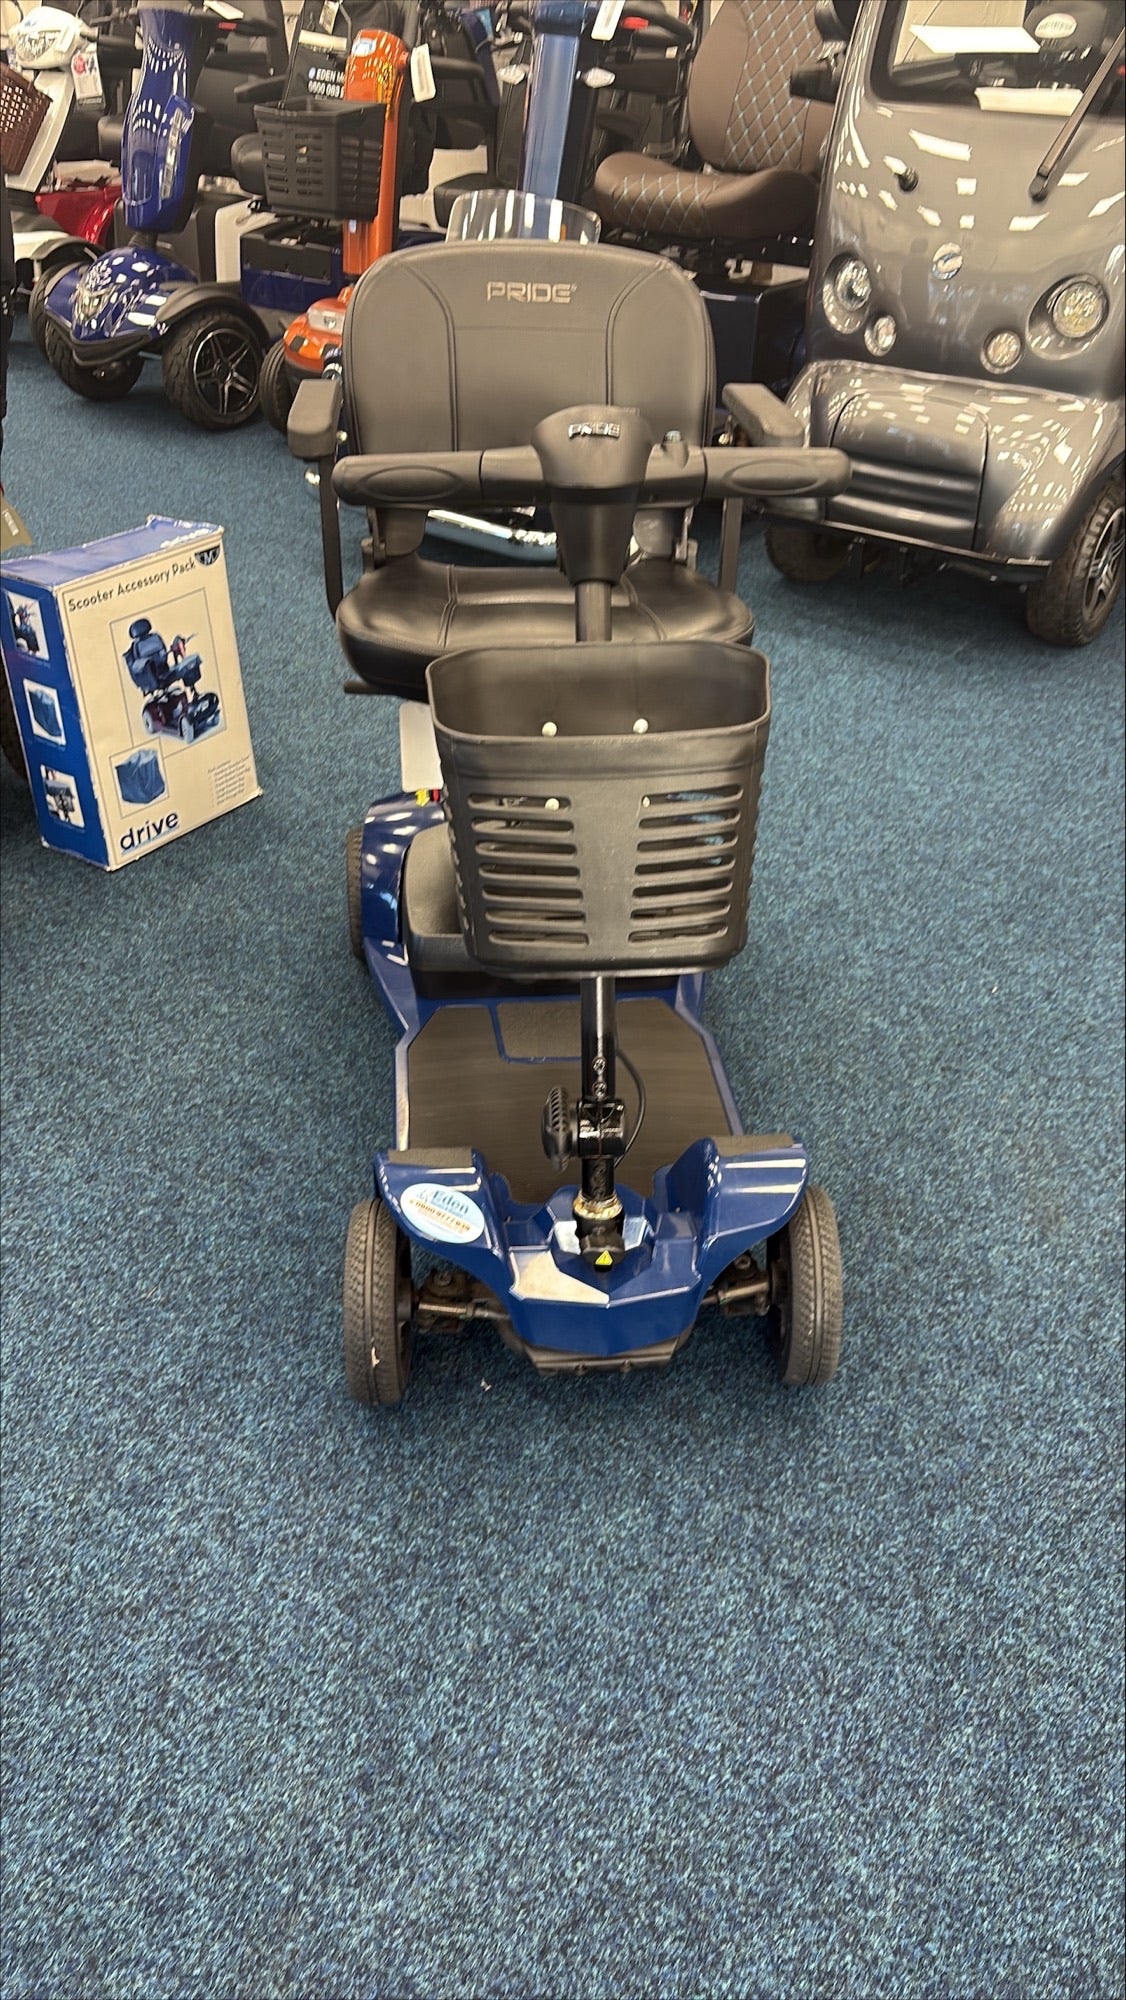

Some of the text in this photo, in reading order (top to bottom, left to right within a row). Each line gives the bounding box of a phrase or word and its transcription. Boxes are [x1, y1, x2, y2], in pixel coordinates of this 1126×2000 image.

[315, 68, 335, 81] EDEN
[308, 80, 325, 95] 0800
[67, 557, 196, 611] Scooter Accessory Pack
[120, 812, 179, 850] drive
[432, 1190, 469, 1214] Eden
